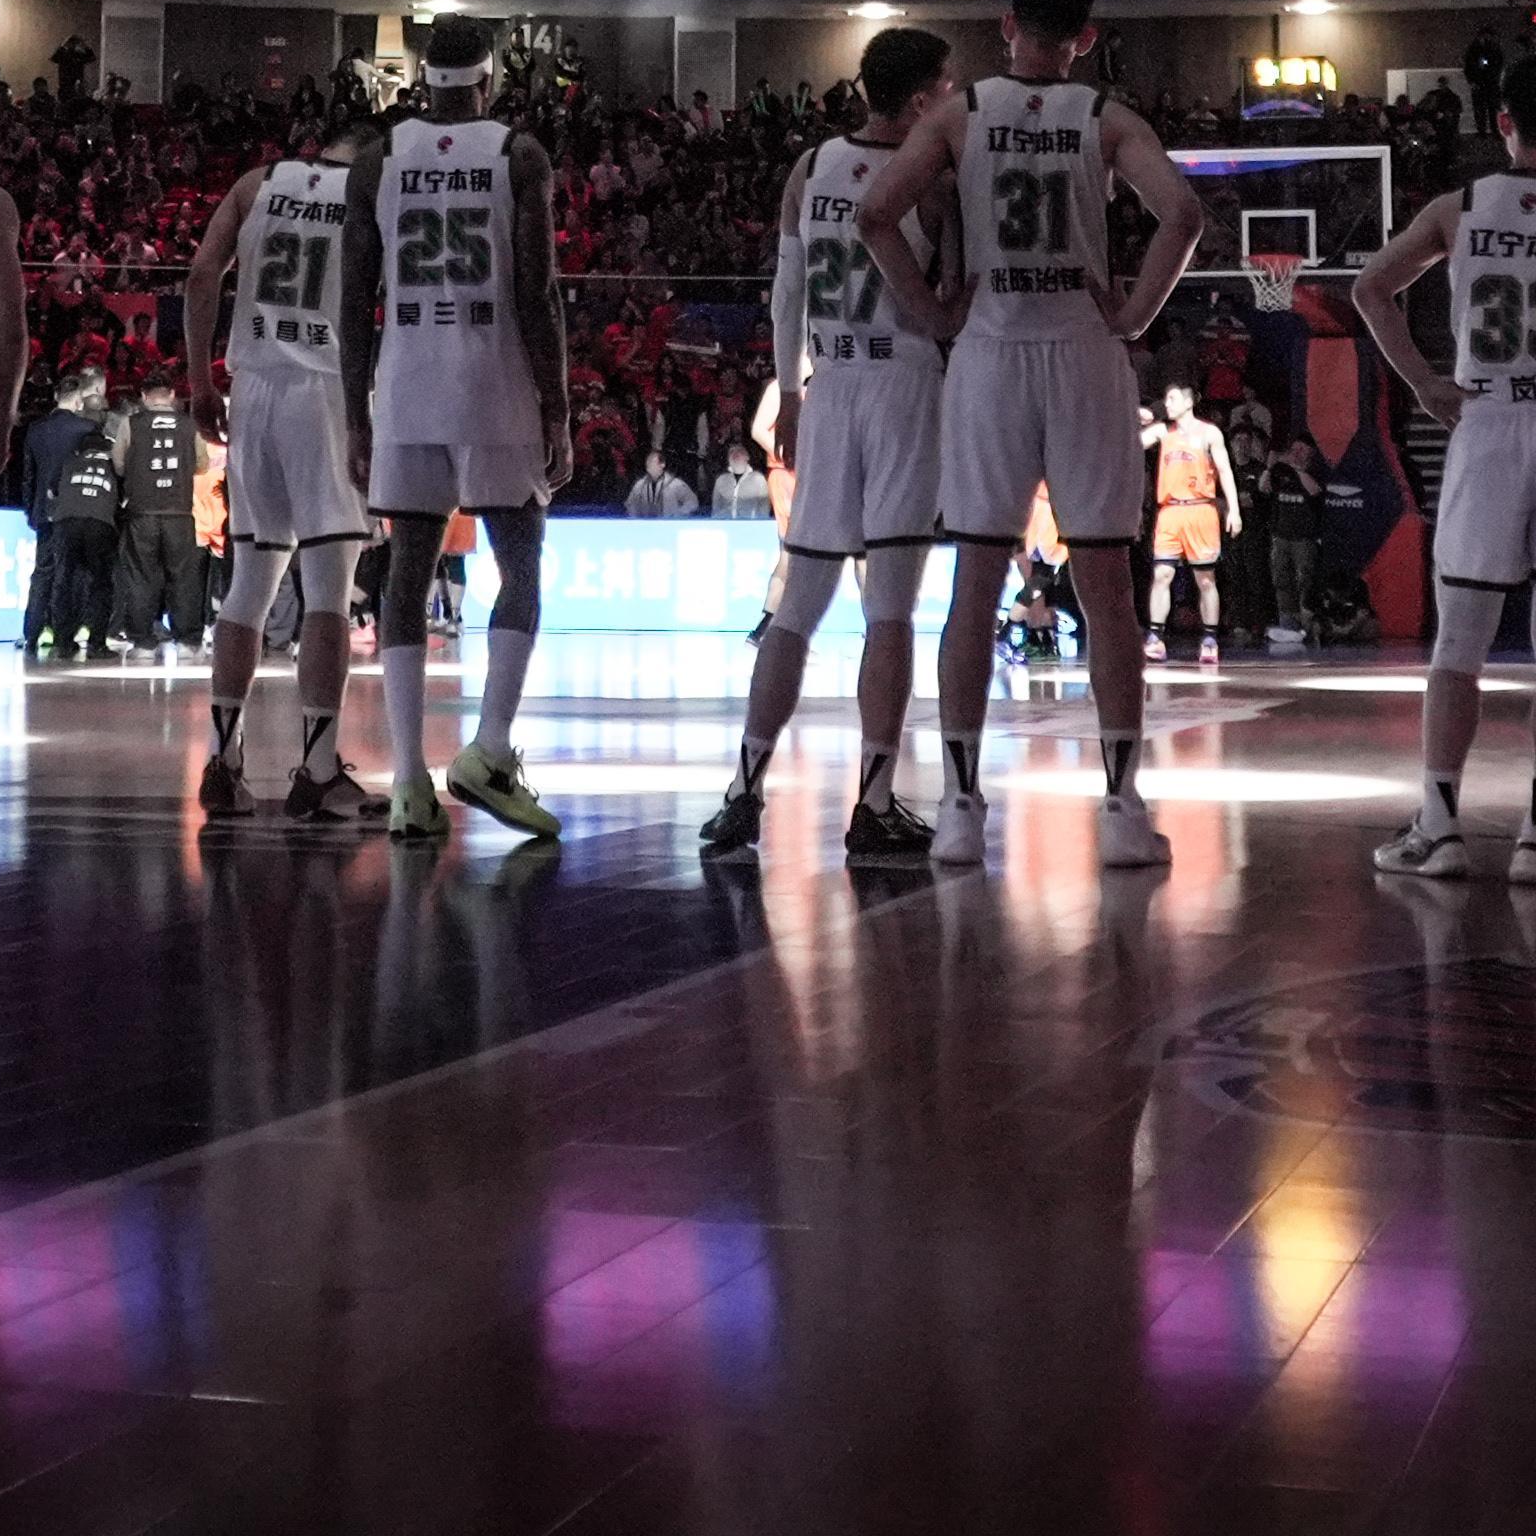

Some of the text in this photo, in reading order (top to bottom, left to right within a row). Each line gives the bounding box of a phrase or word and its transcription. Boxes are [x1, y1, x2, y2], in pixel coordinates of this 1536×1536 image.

[989, 126, 1081, 154] 辽宁本钢
[267, 194, 347, 225] 辽宁本钢
[401, 168, 492, 194] 辽宁本钢
[994, 168, 1070, 254] 31
[256, 232, 331, 310] 21
[397, 207, 492, 287] 25
[807, 237, 884, 325] 27
